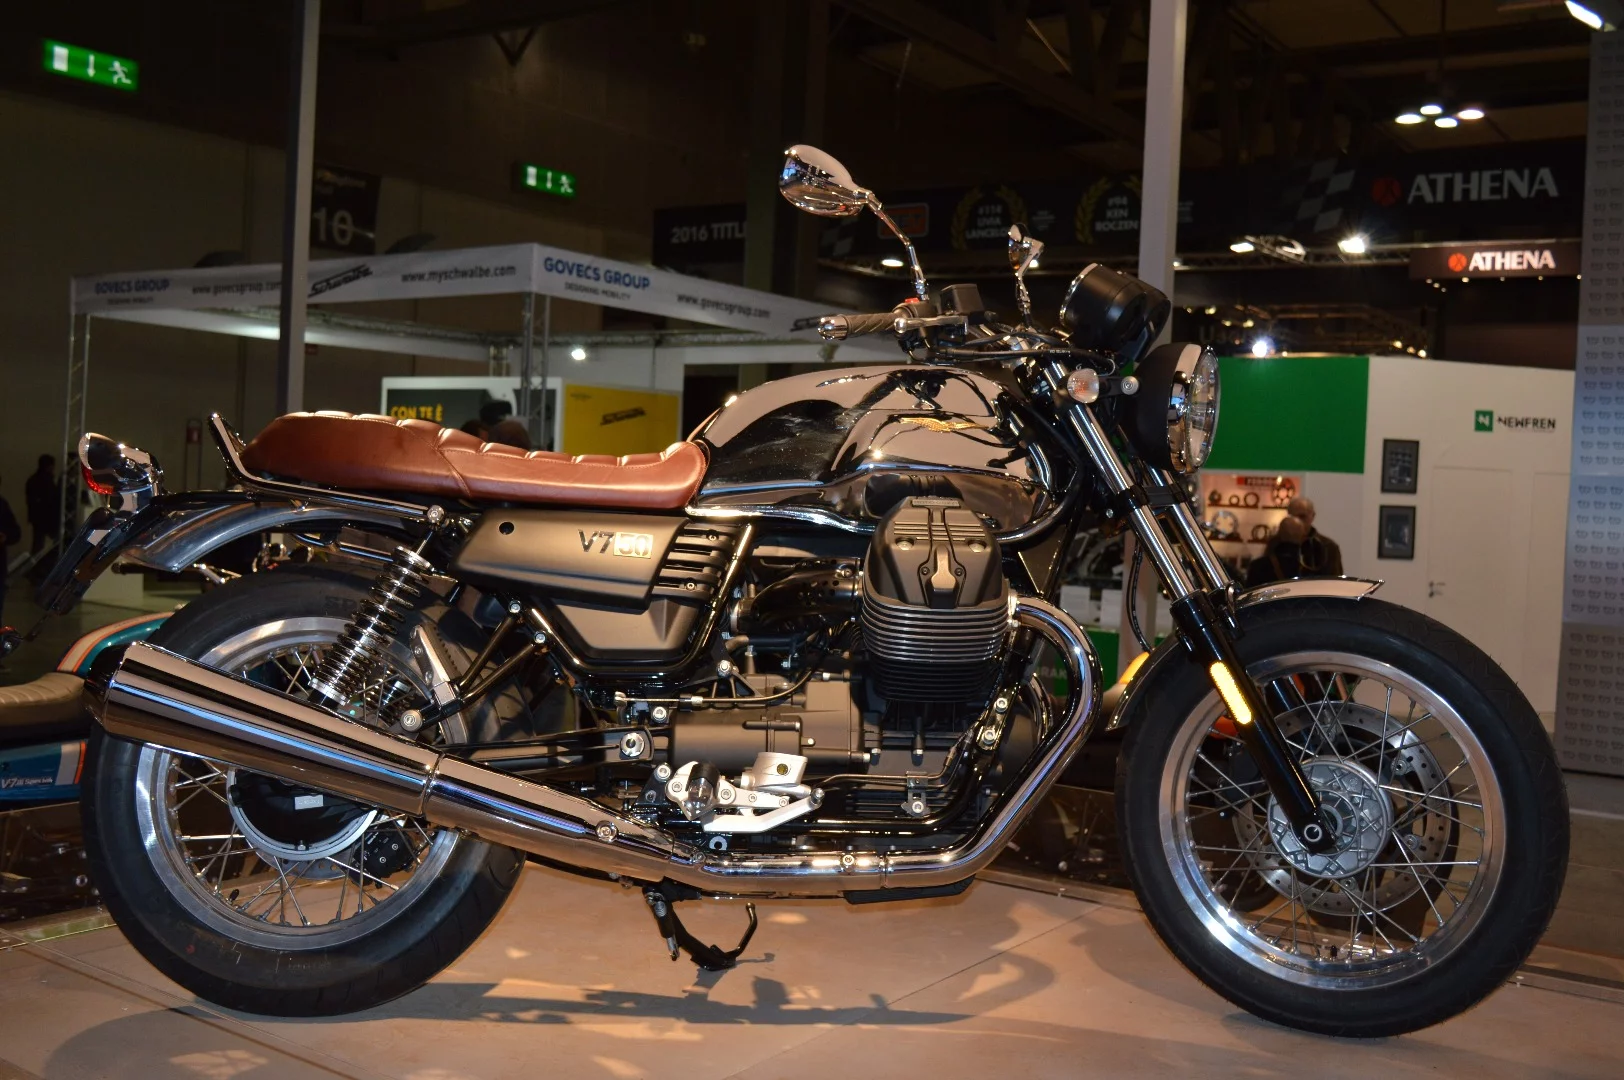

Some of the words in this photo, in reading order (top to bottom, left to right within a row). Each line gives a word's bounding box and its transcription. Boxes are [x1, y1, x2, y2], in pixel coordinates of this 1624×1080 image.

[1407, 167, 1560, 204] ATHENA
[312, 206, 354, 246] 10
[670, 224, 709, 244] 2016
[710, 221, 746, 241] TITL
[1468, 249, 1557, 272] ATHENA
[401, 264, 517, 286] www.myschwalbe.com
[543, 256, 601, 283] GOVECS
[603, 268, 651, 291] GROUP
[95, 278, 132, 295] GOVECS
[134, 276, 171, 292] GROUP
[676, 293, 771, 319] www.govecsgroup.com
[1497, 415, 1557, 430] NEWFREN
